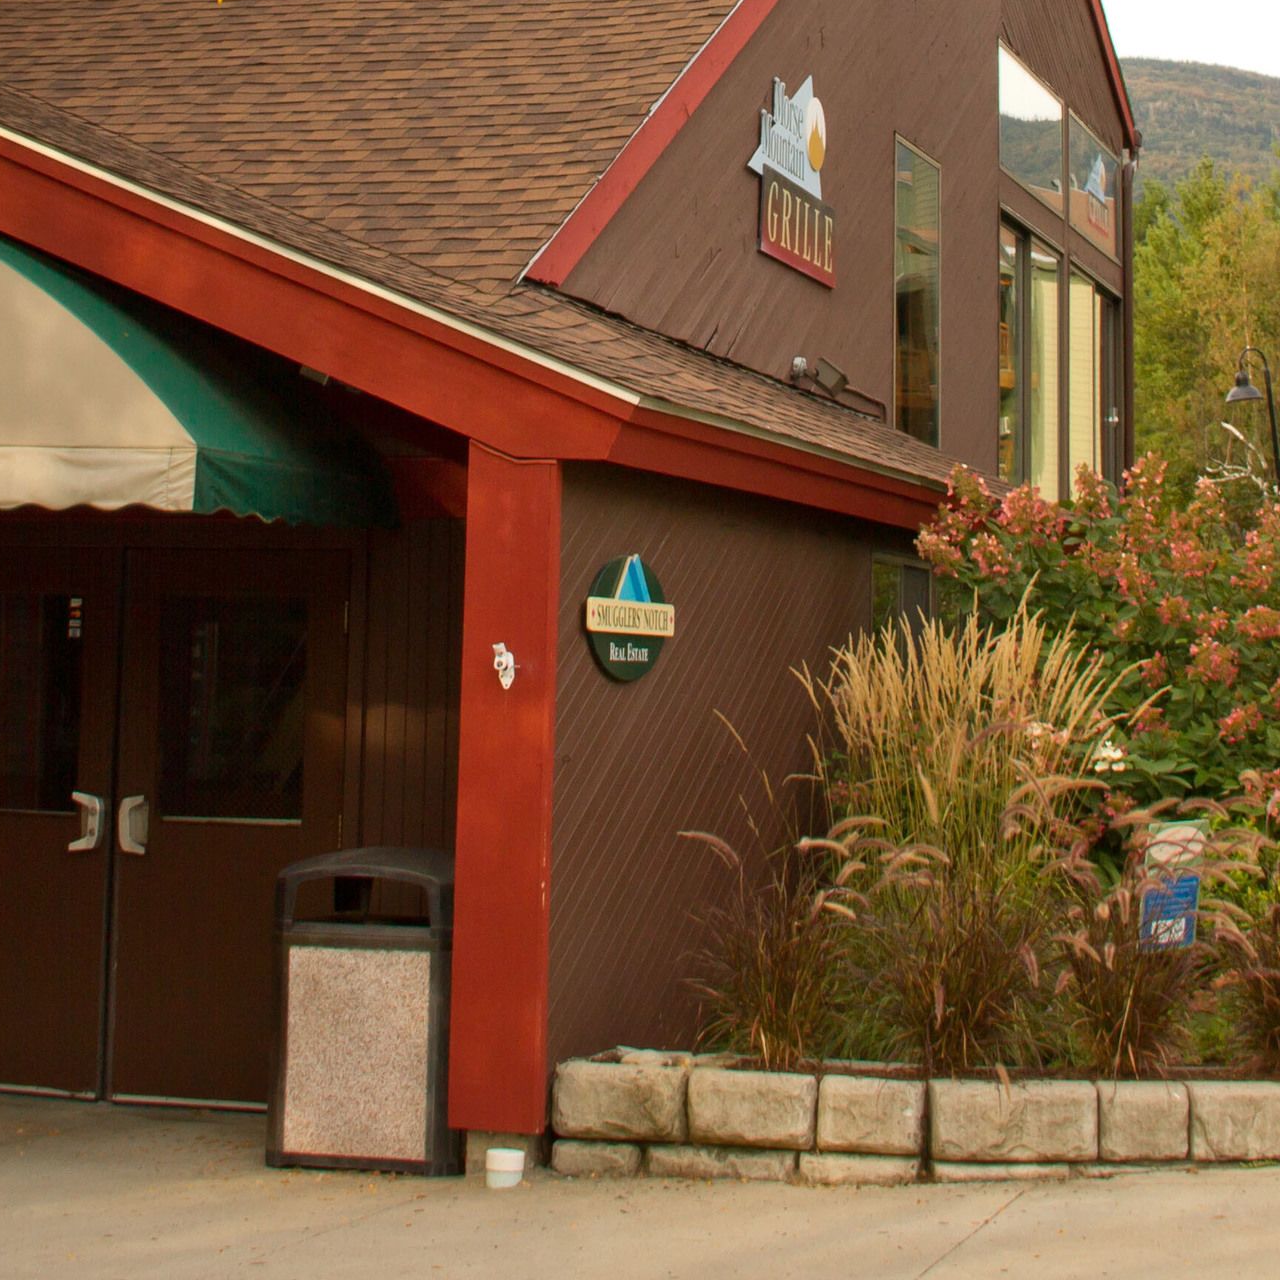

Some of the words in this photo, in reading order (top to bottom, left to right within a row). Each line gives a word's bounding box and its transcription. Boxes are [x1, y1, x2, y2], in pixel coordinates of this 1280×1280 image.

[774, 77, 803, 140] Morse
[761, 108, 805, 181] Mountain
[767, 181, 833, 274] GRILLE
[644, 609, 669, 631] NOTCH
